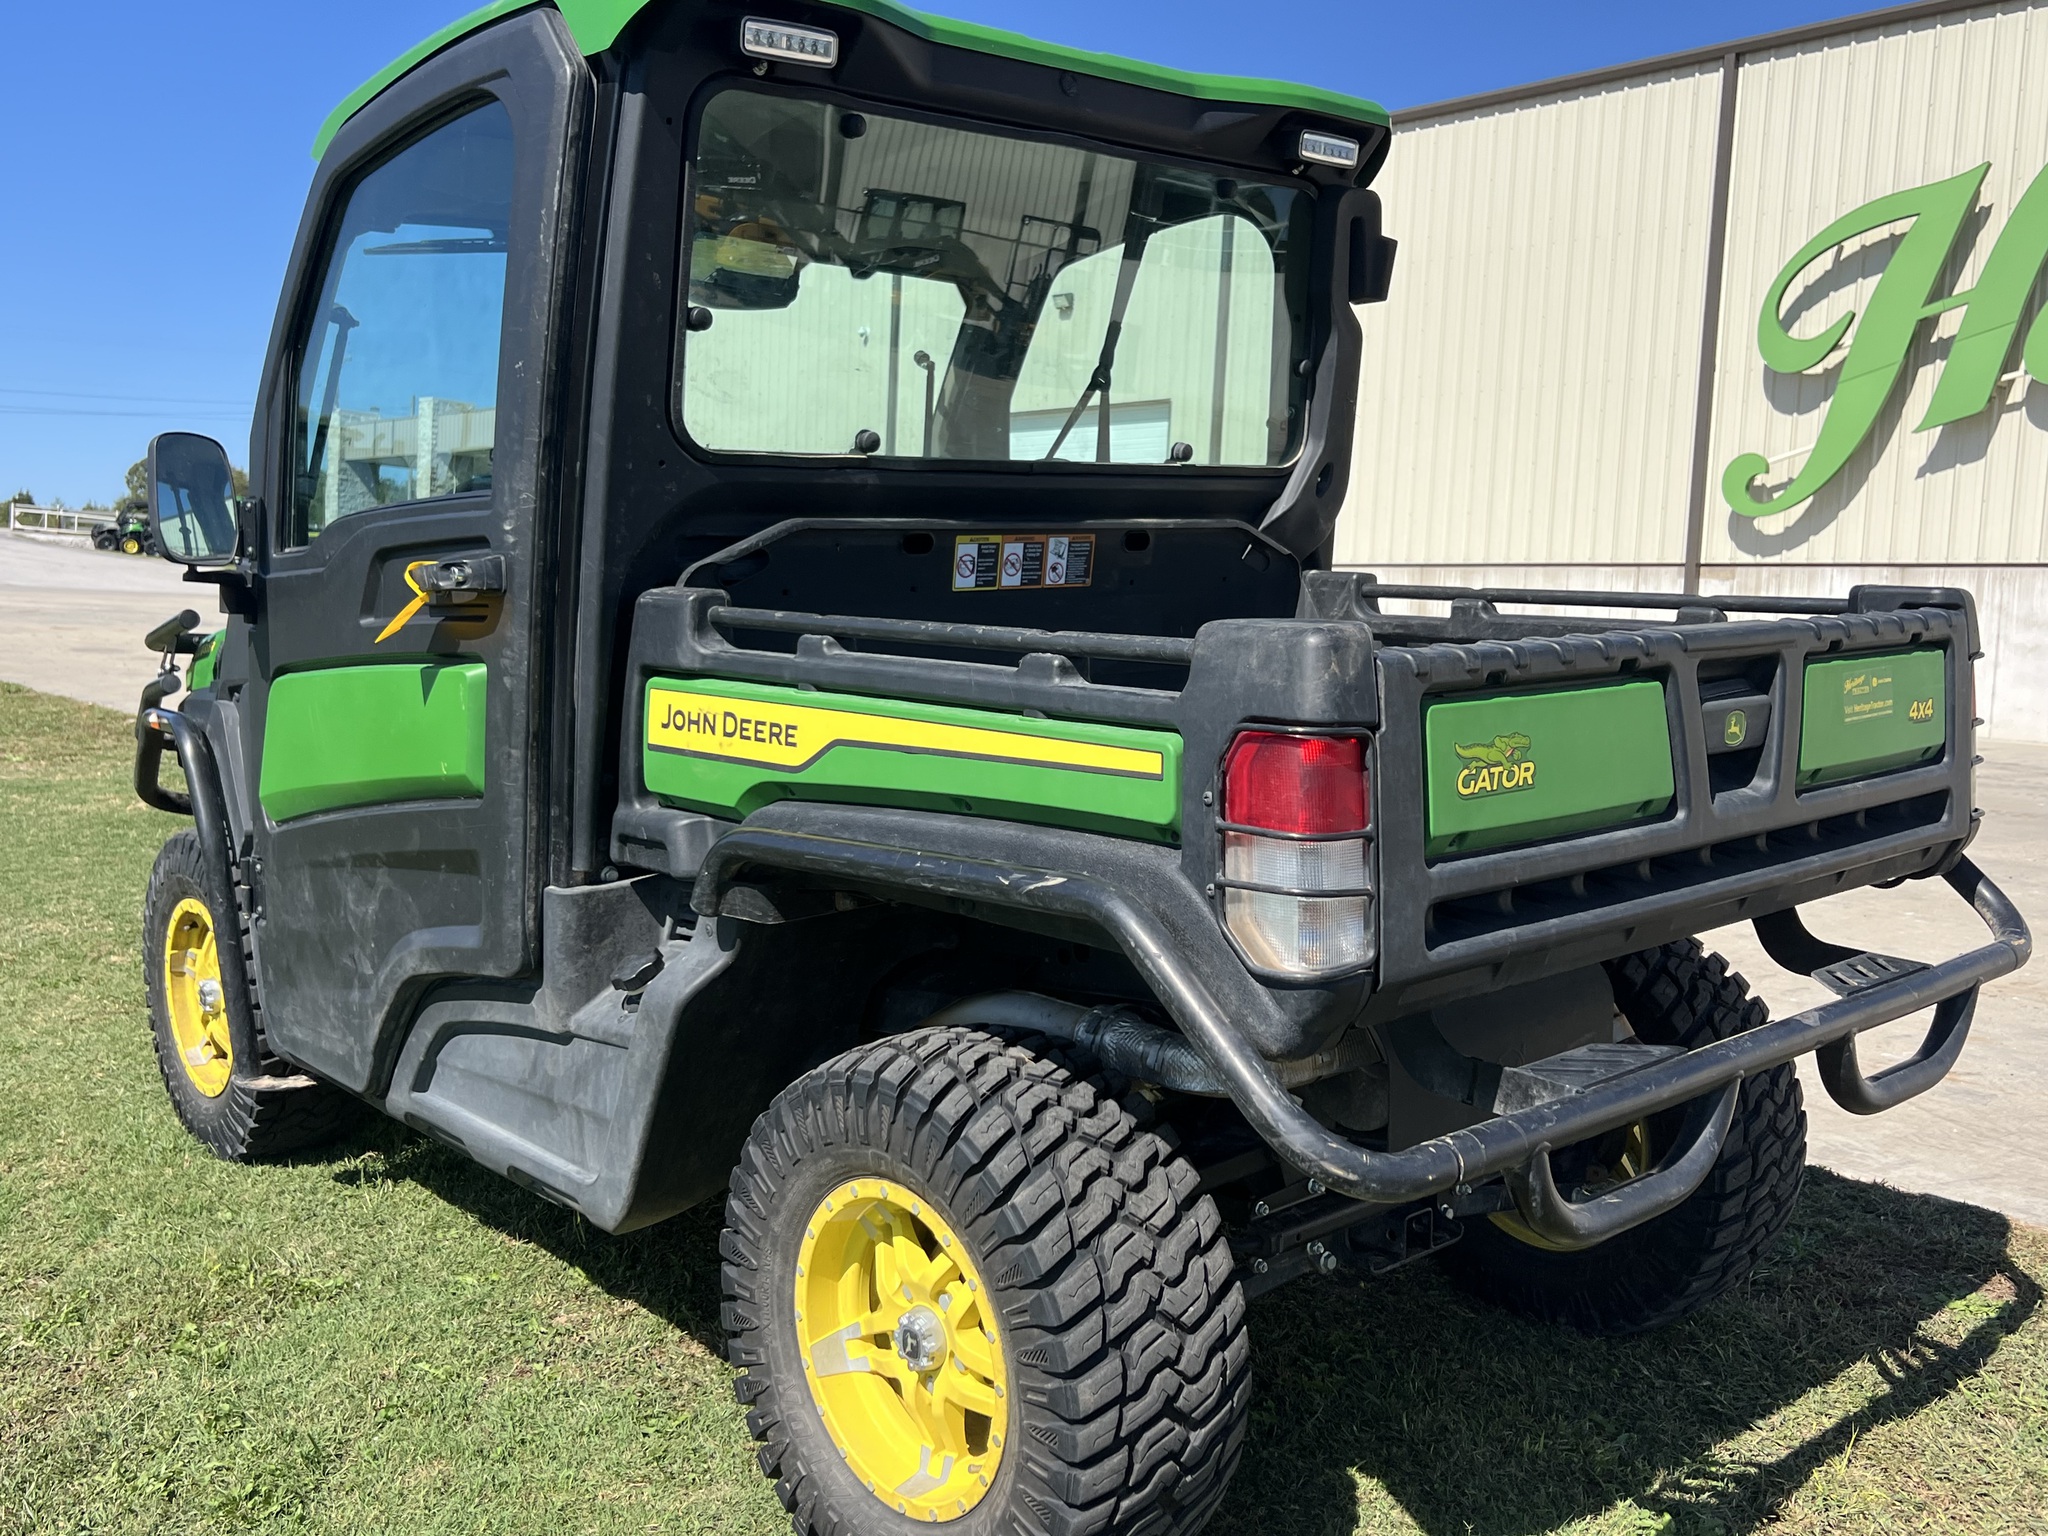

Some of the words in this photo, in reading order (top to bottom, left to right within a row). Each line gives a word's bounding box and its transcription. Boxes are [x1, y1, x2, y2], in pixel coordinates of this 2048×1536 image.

[661, 703, 716, 736] JOHN
[723, 711, 798, 747] DEERE
[1457, 761, 1535, 795] GATOR
